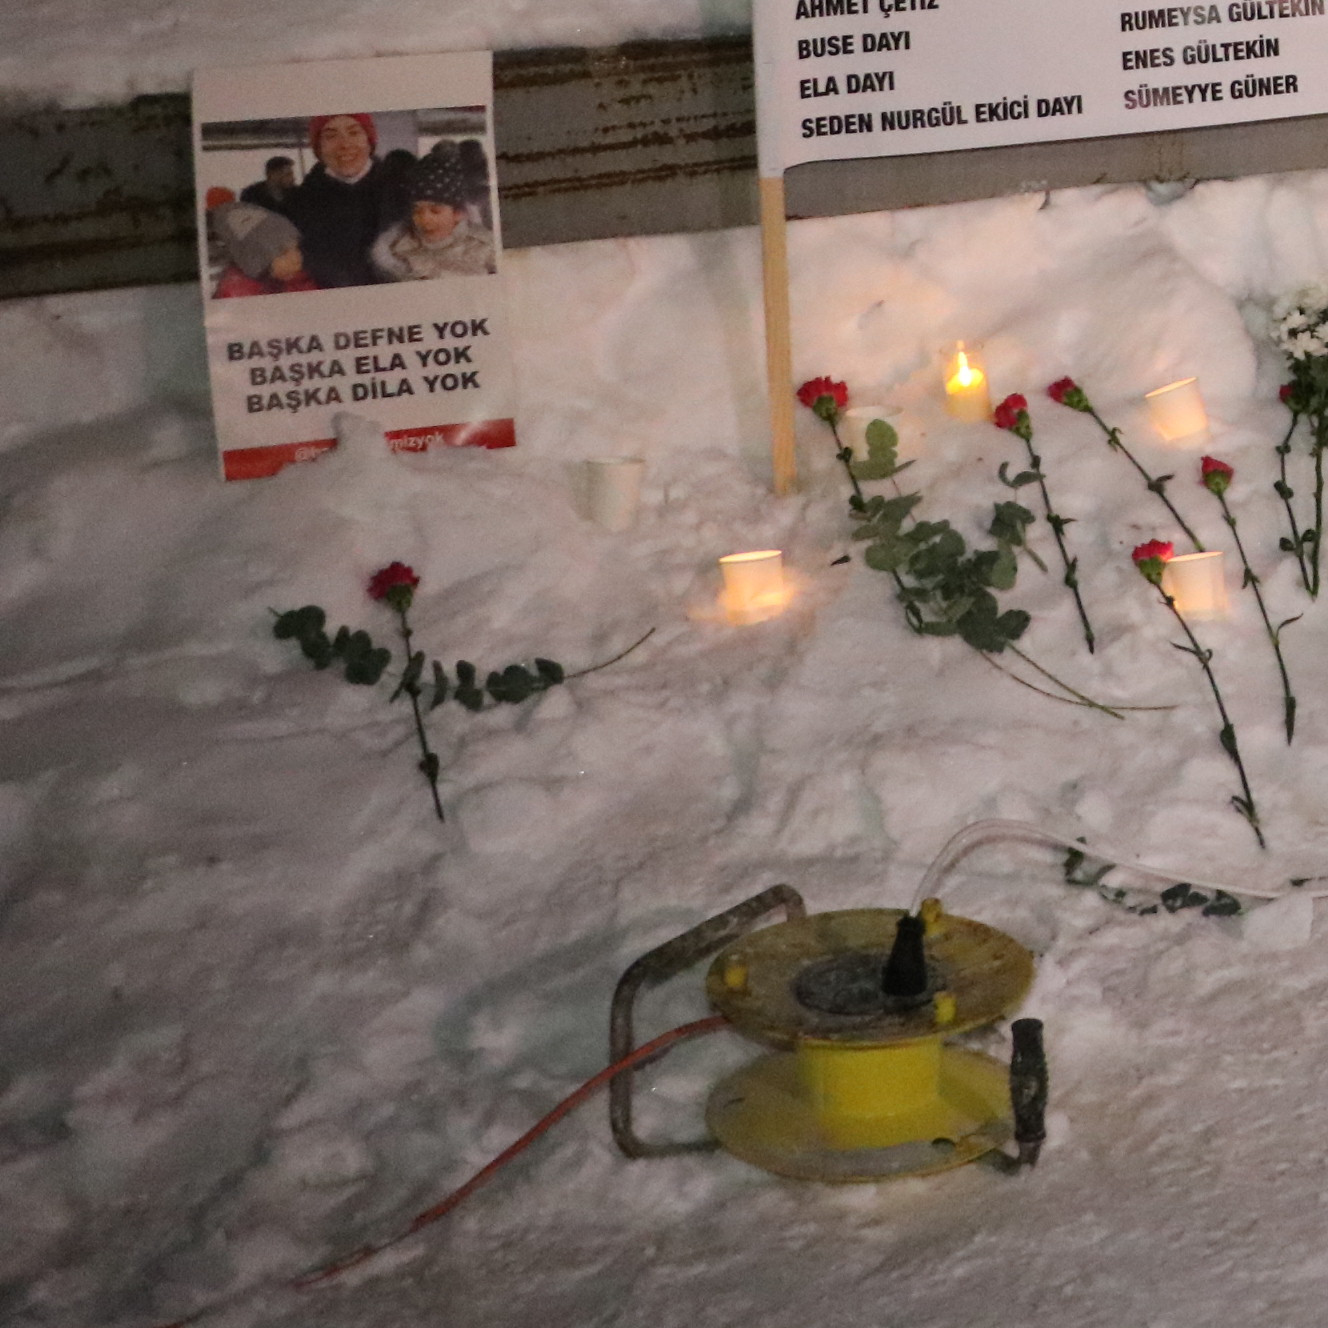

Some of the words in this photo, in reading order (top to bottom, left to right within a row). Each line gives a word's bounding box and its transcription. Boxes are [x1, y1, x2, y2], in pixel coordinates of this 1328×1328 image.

[1120, 5, 1221, 32] RUMEYSA
[798, 35, 854, 60] BUSE
[862, 31, 910, 53] DAYI
[1122, 47, 1175, 71] ENES
[1182, 34, 1279, 65] GÜLTEKİN
[799, 76, 839, 99] ELA
[846, 71, 895, 94] DAYI
[1124, 82, 1223, 109] SÜMEYYE
[1230, 74, 1298, 100] GÜNER
[801, 113, 873, 139] SEDEN
[881, 101, 968, 131] NURGÜL
[975, 95, 1029, 123] EKİCİ
[1037, 95, 1083, 118] DAYI
[227, 334, 322, 361] BAŞKA
[334, 324, 423, 350] DEFNE
[432, 318, 490, 340] YOK
[250, 359, 345, 387] BAŞKA
[355, 353, 407, 375] ELA
[415, 345, 472, 368] YOK
[247, 385, 342, 413] BAŞKA
[351, 377, 414, 402] DİLA
[423, 371, 480, 393] YOK
